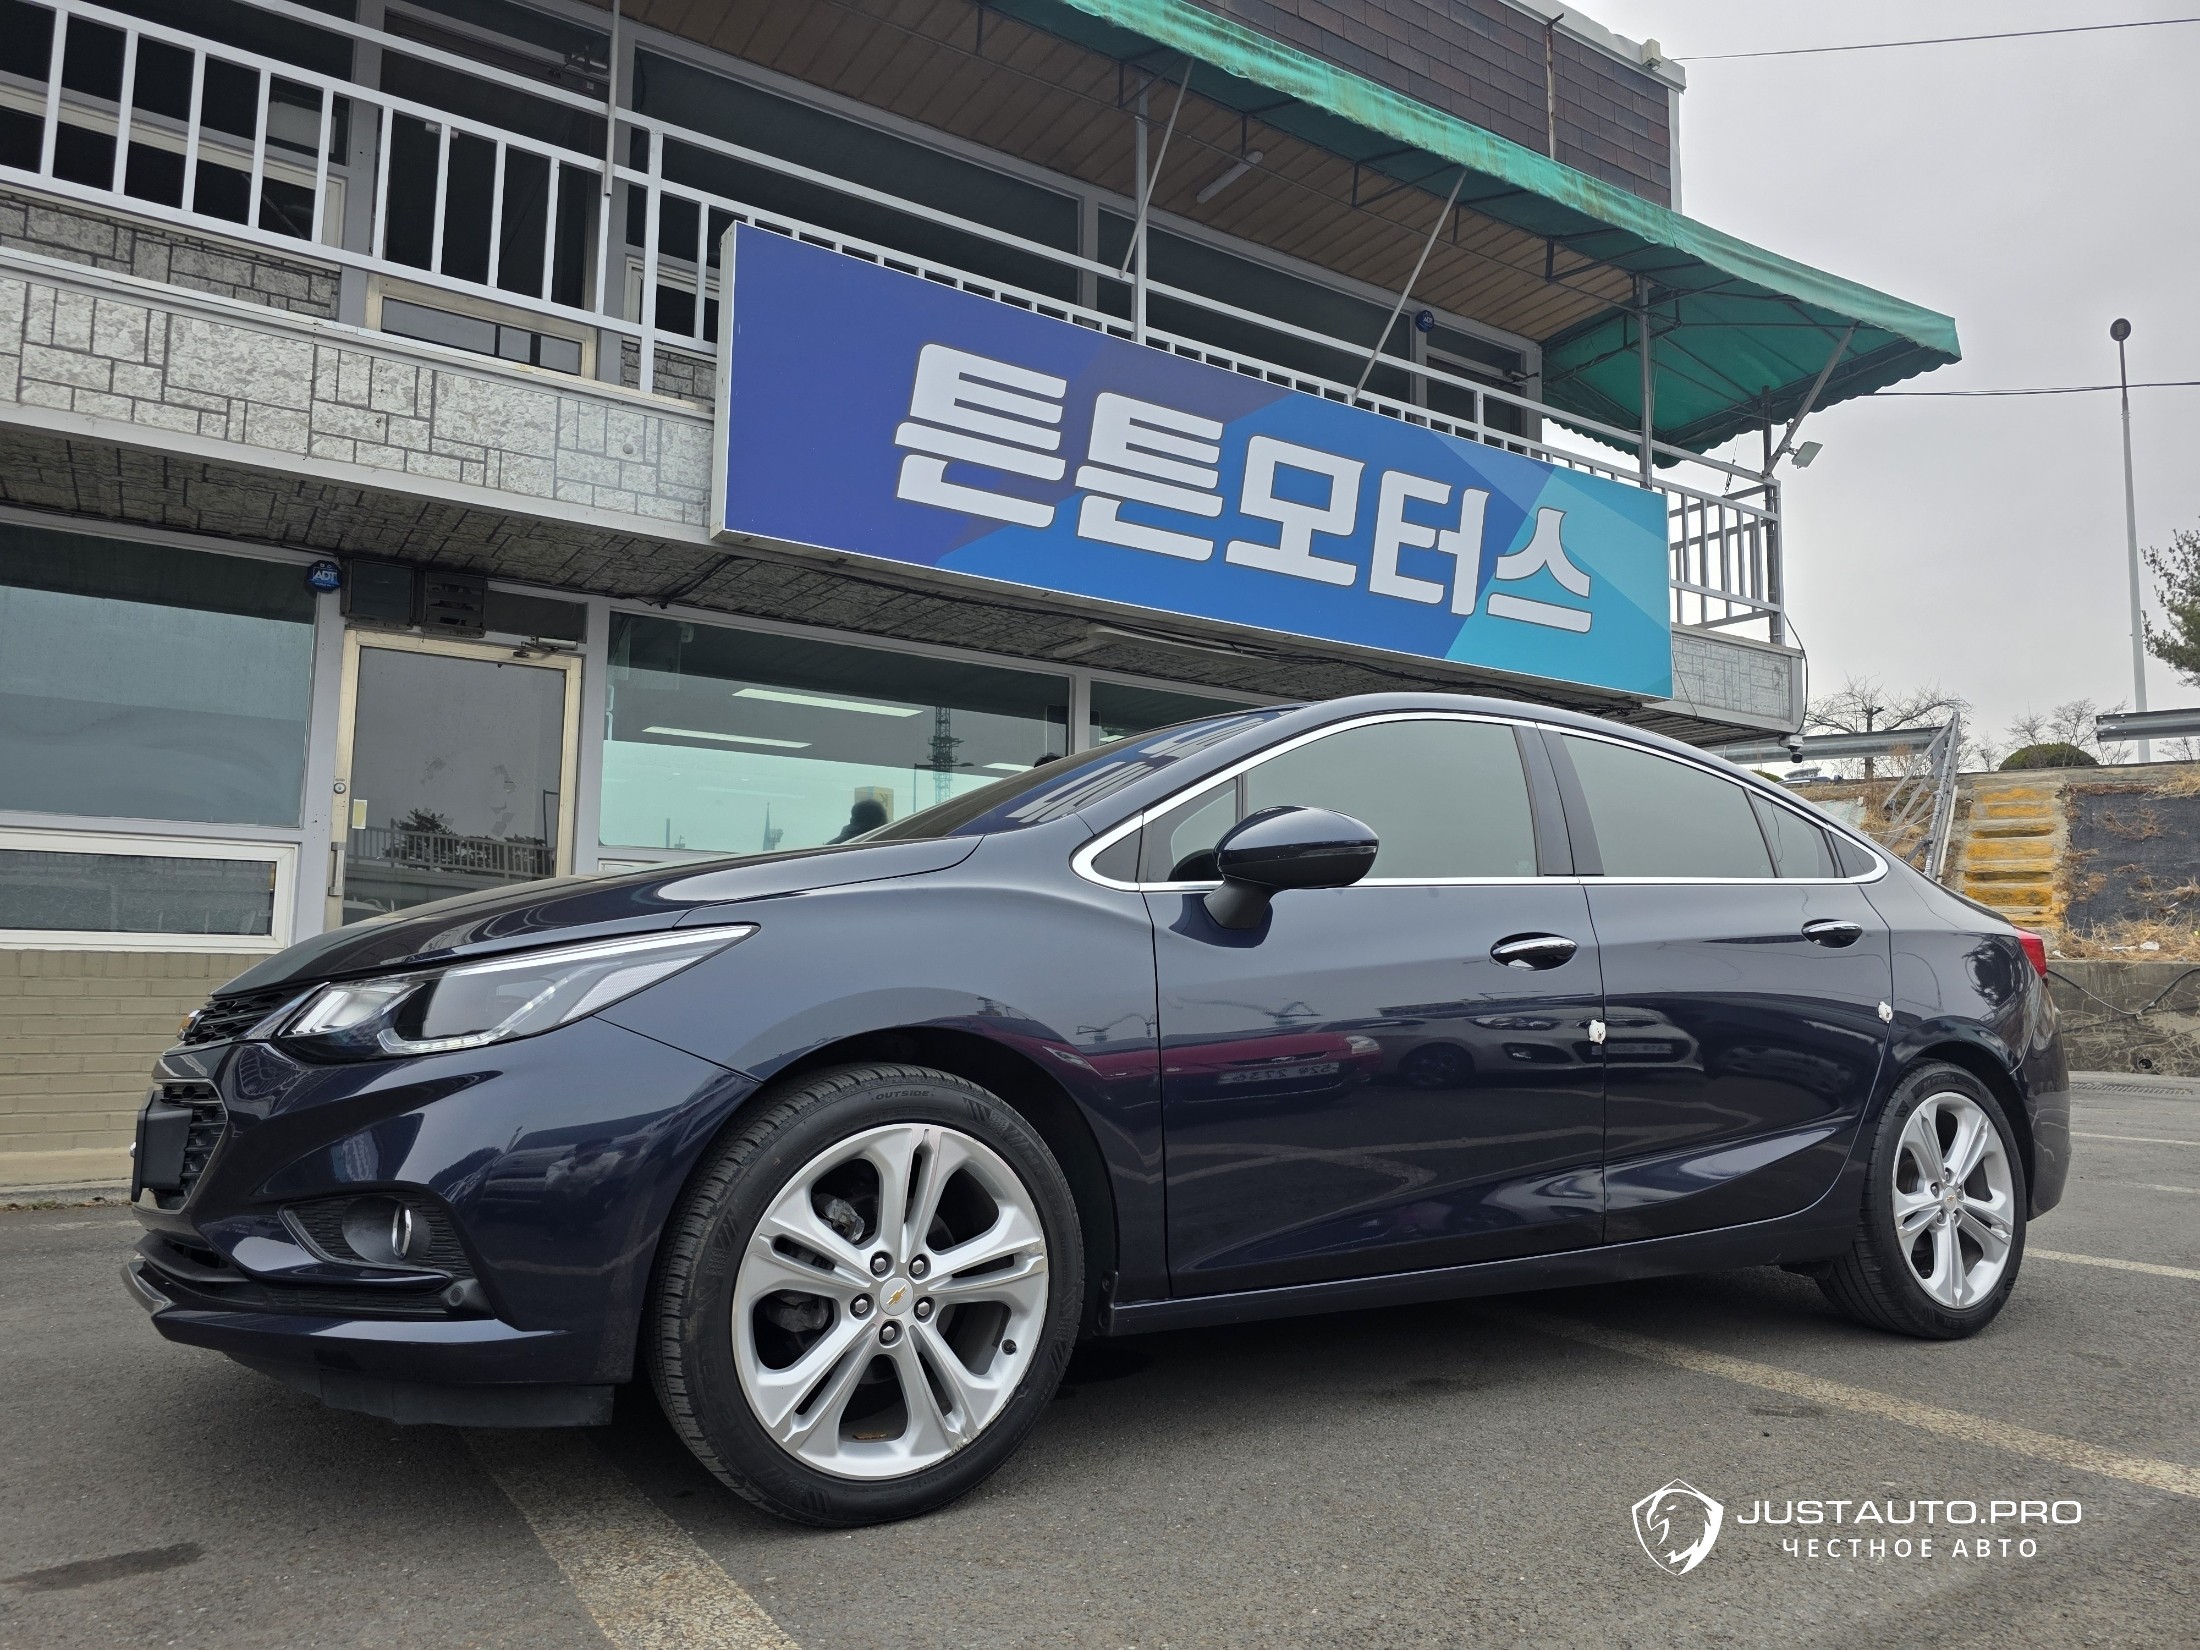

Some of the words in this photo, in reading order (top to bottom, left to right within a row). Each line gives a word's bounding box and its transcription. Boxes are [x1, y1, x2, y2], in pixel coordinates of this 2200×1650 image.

[894, 343, 1593, 633] 튼튼모터스
[314, 570, 337, 582] ADT
[875, 1090, 930, 1100] OUTSIDE
